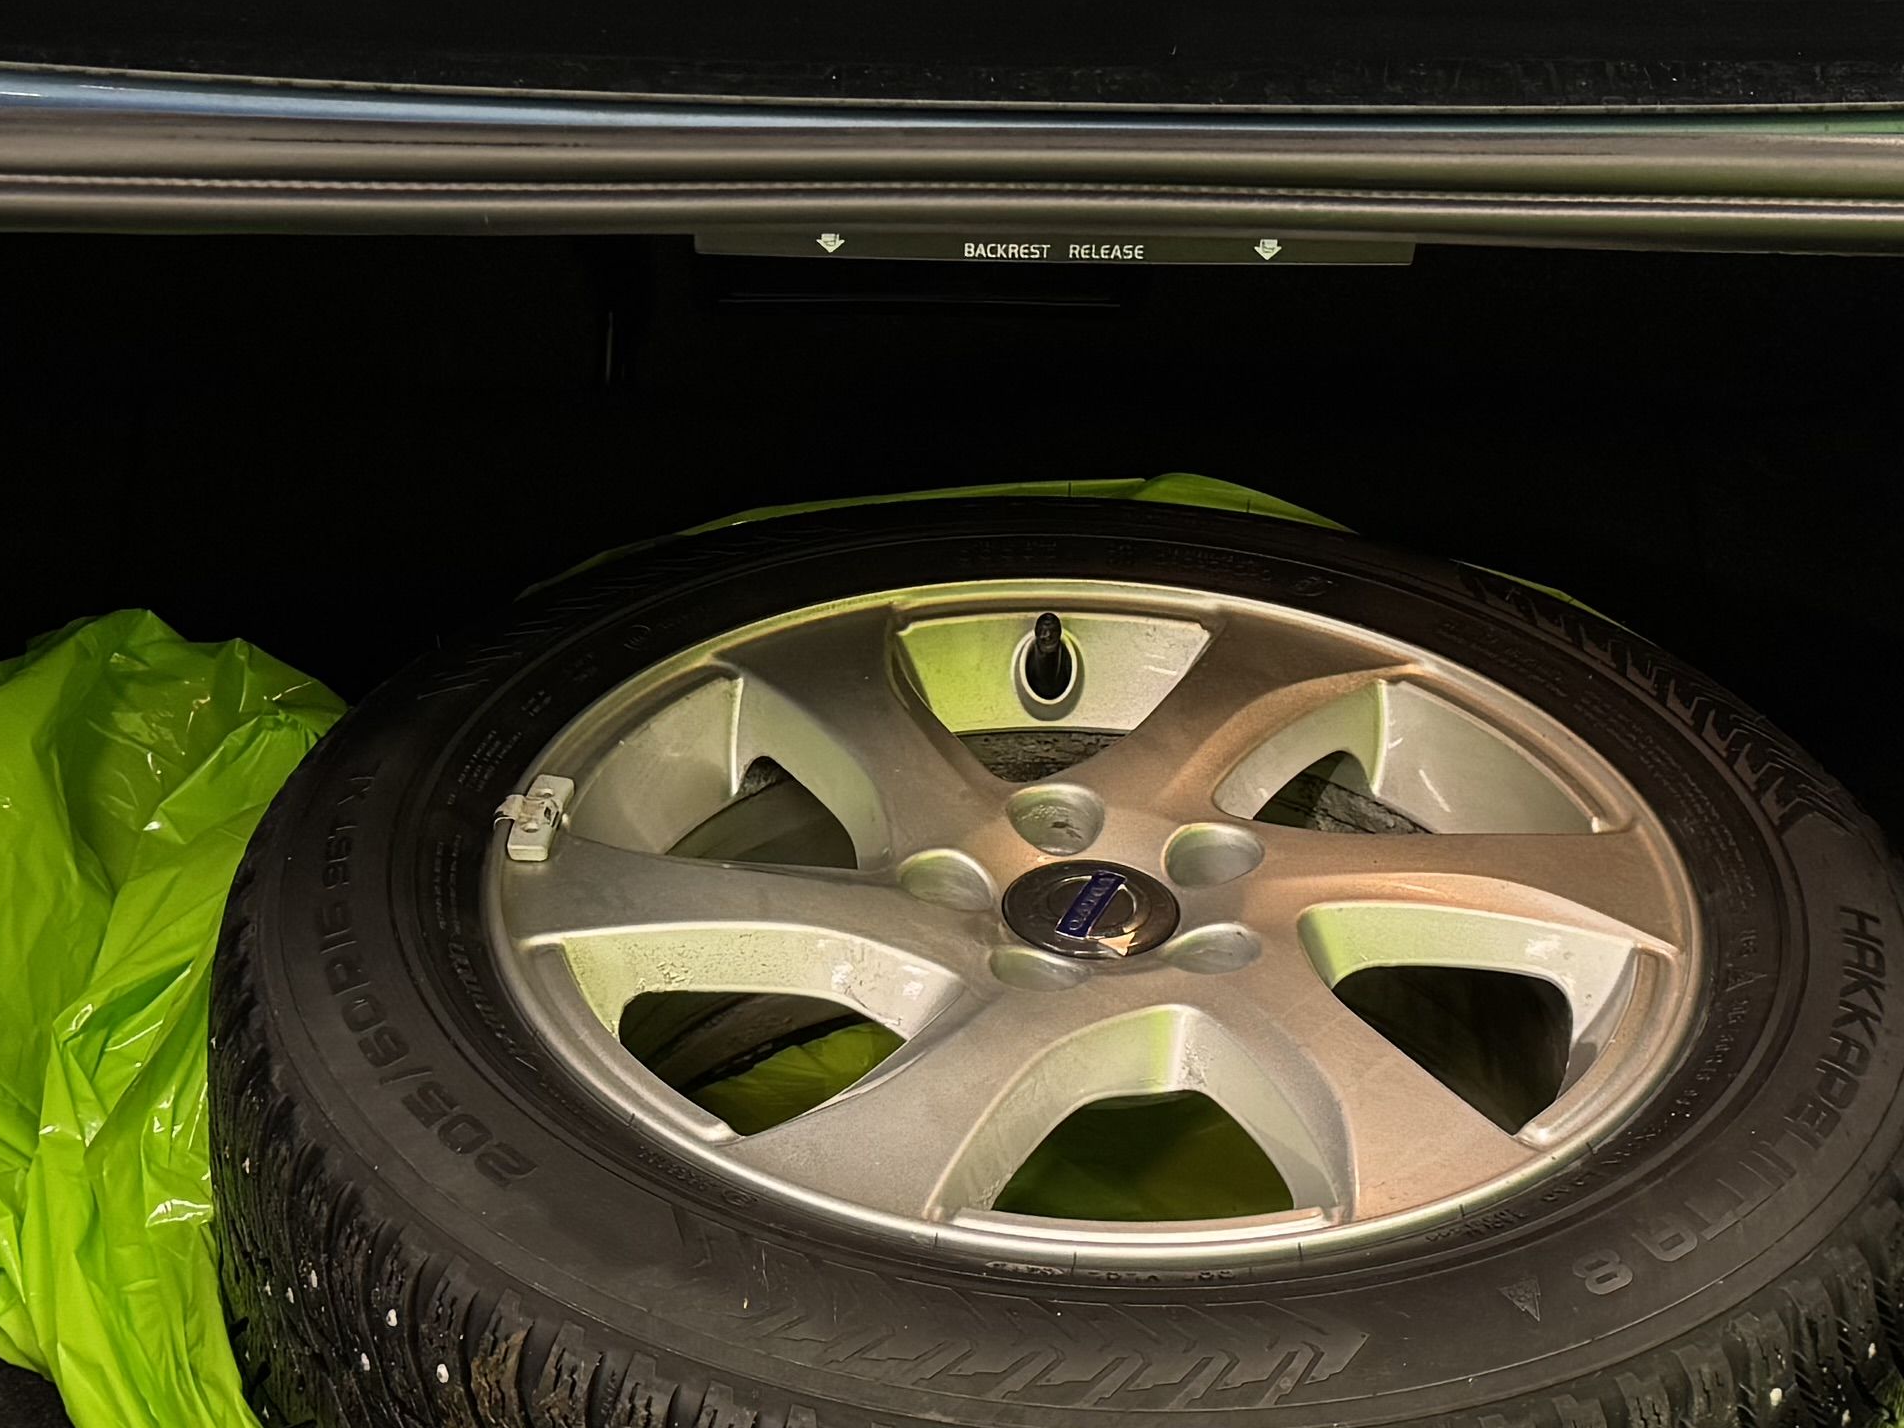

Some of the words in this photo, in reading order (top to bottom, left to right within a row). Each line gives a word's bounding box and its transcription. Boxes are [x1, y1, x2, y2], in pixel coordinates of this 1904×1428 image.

[963, 242, 1051, 259] BACKREST
[1068, 243, 1145, 260] RELEASE
[1572, 1248, 1634, 1296] 8
